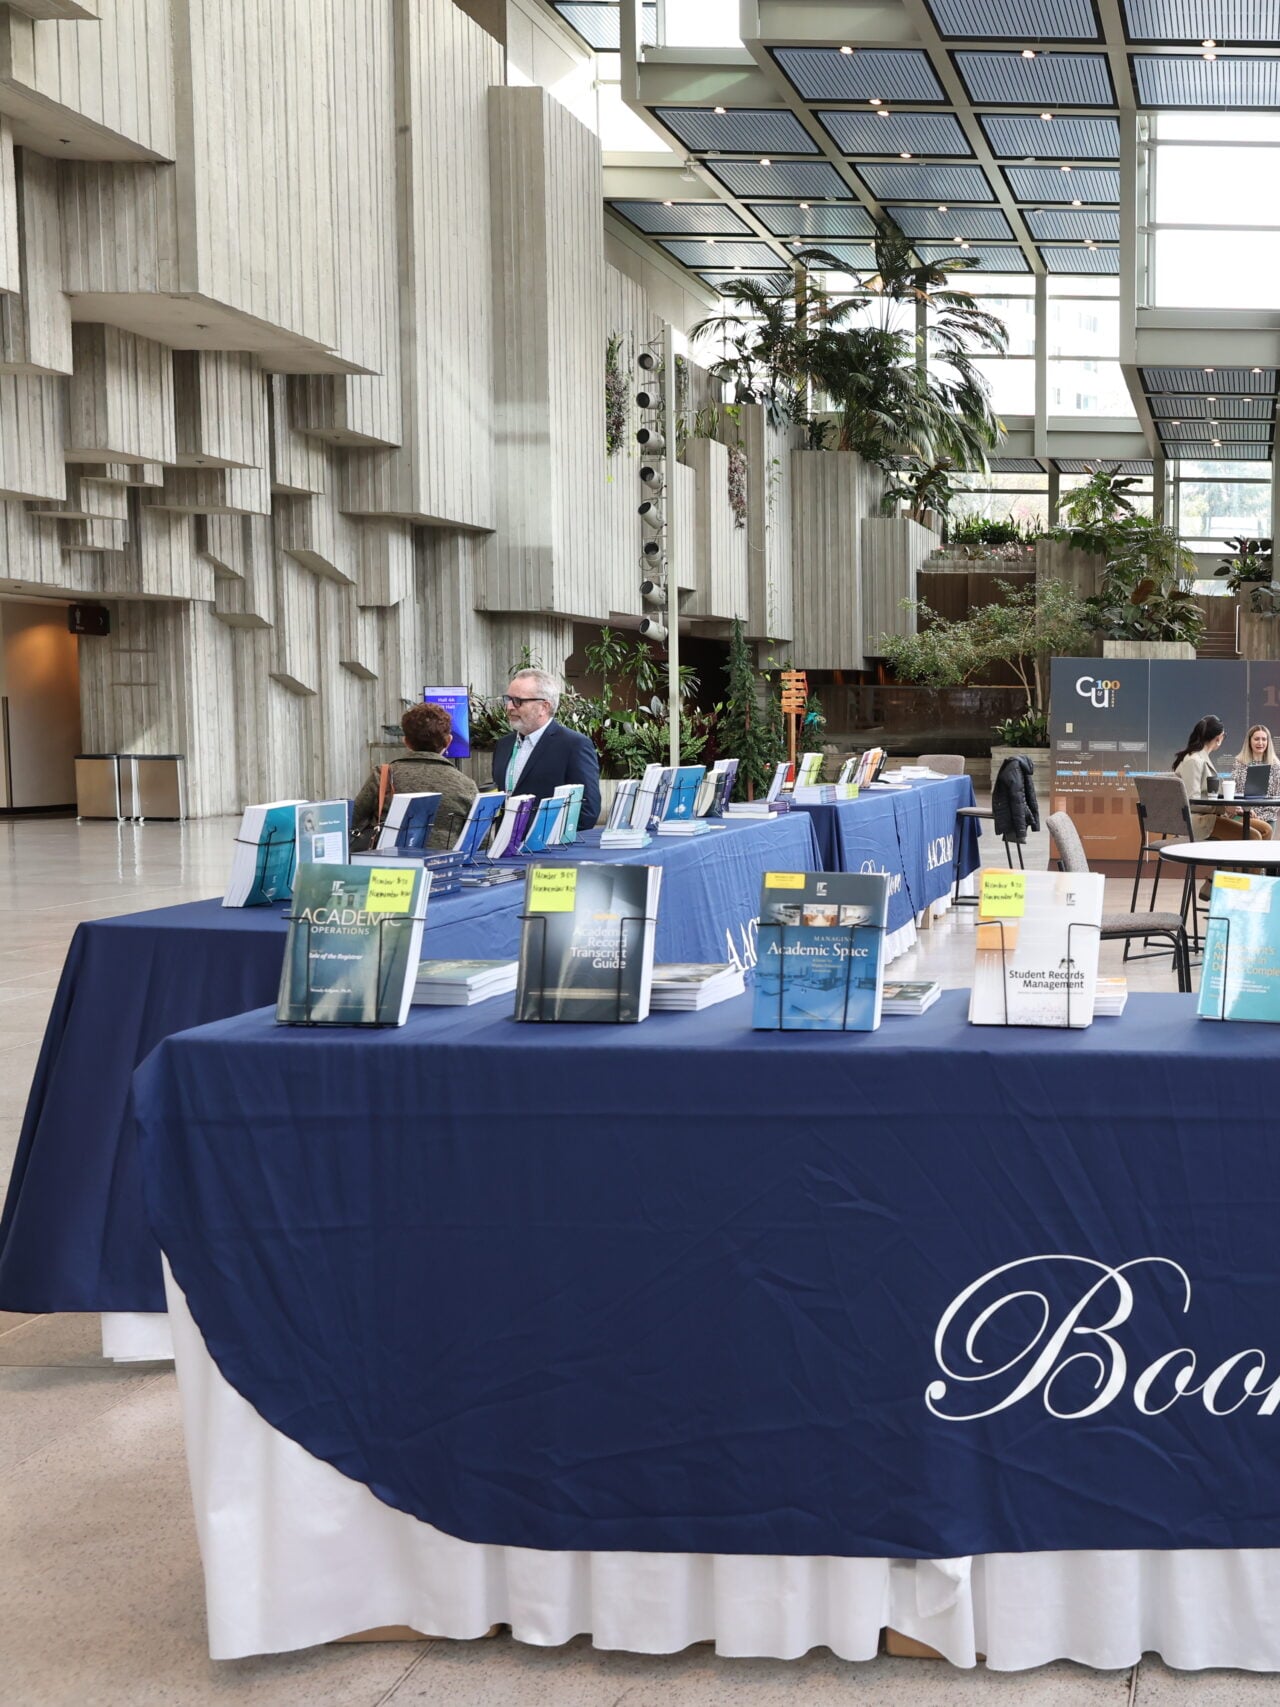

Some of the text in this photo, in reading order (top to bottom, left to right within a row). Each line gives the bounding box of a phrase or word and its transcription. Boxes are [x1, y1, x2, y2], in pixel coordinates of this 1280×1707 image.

[1096, 680, 1121, 690] 100
[299, 907, 402, 928] ACADEMIC
[311, 926, 370, 936] OPERATIONS
[573, 927, 628, 937] Academc
[592, 957, 627, 969] Guide
[1009, 969, 1085, 980] Student Records
[1022, 980, 1084, 991] Management
